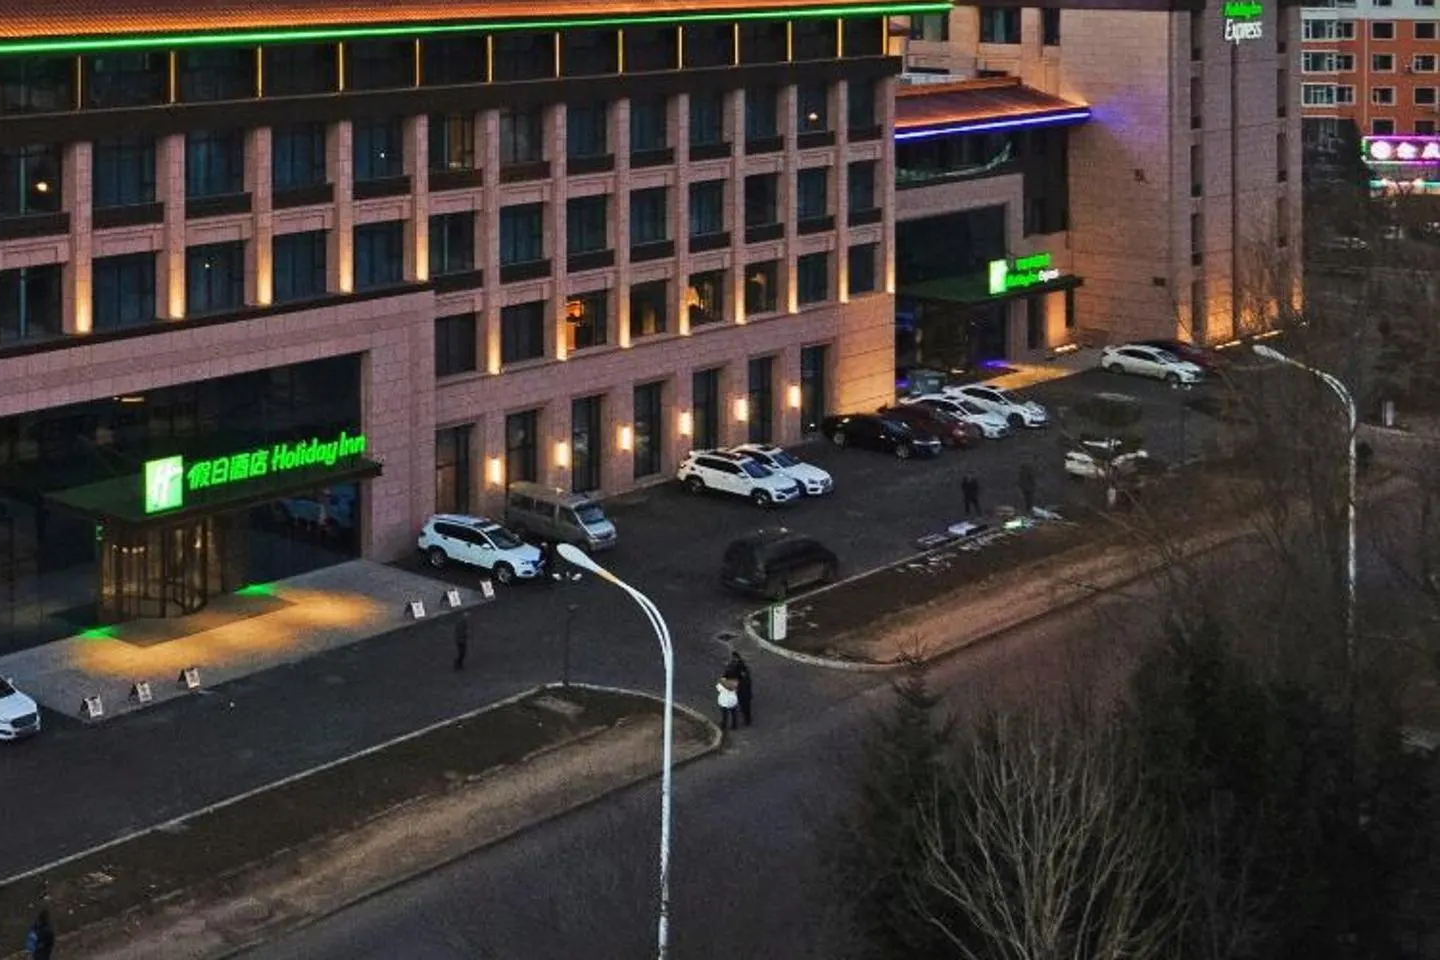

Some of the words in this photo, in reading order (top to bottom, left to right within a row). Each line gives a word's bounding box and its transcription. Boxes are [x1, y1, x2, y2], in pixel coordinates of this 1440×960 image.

[186, 449, 269, 490] 假日酒店
[271, 438, 338, 472] Holiday
[338, 431, 366, 457] Inn
